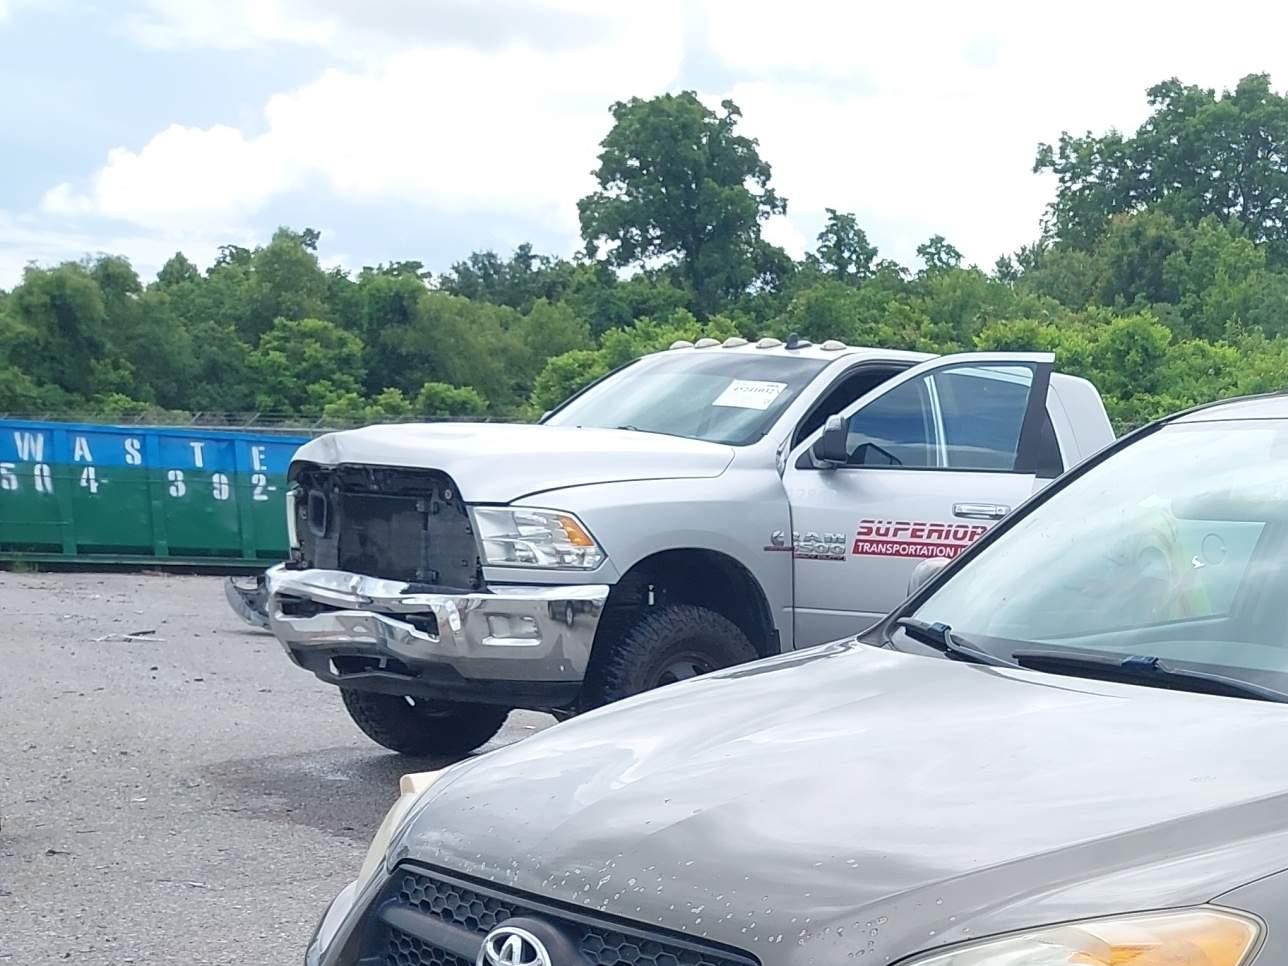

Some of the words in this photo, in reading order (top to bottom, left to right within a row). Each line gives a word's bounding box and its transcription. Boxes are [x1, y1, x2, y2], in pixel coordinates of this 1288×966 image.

[14, 431, 267, 471] WASTE
[856, 520, 988, 542] SUPERIOR
[857, 541, 955, 558] TRANSPORTATION
